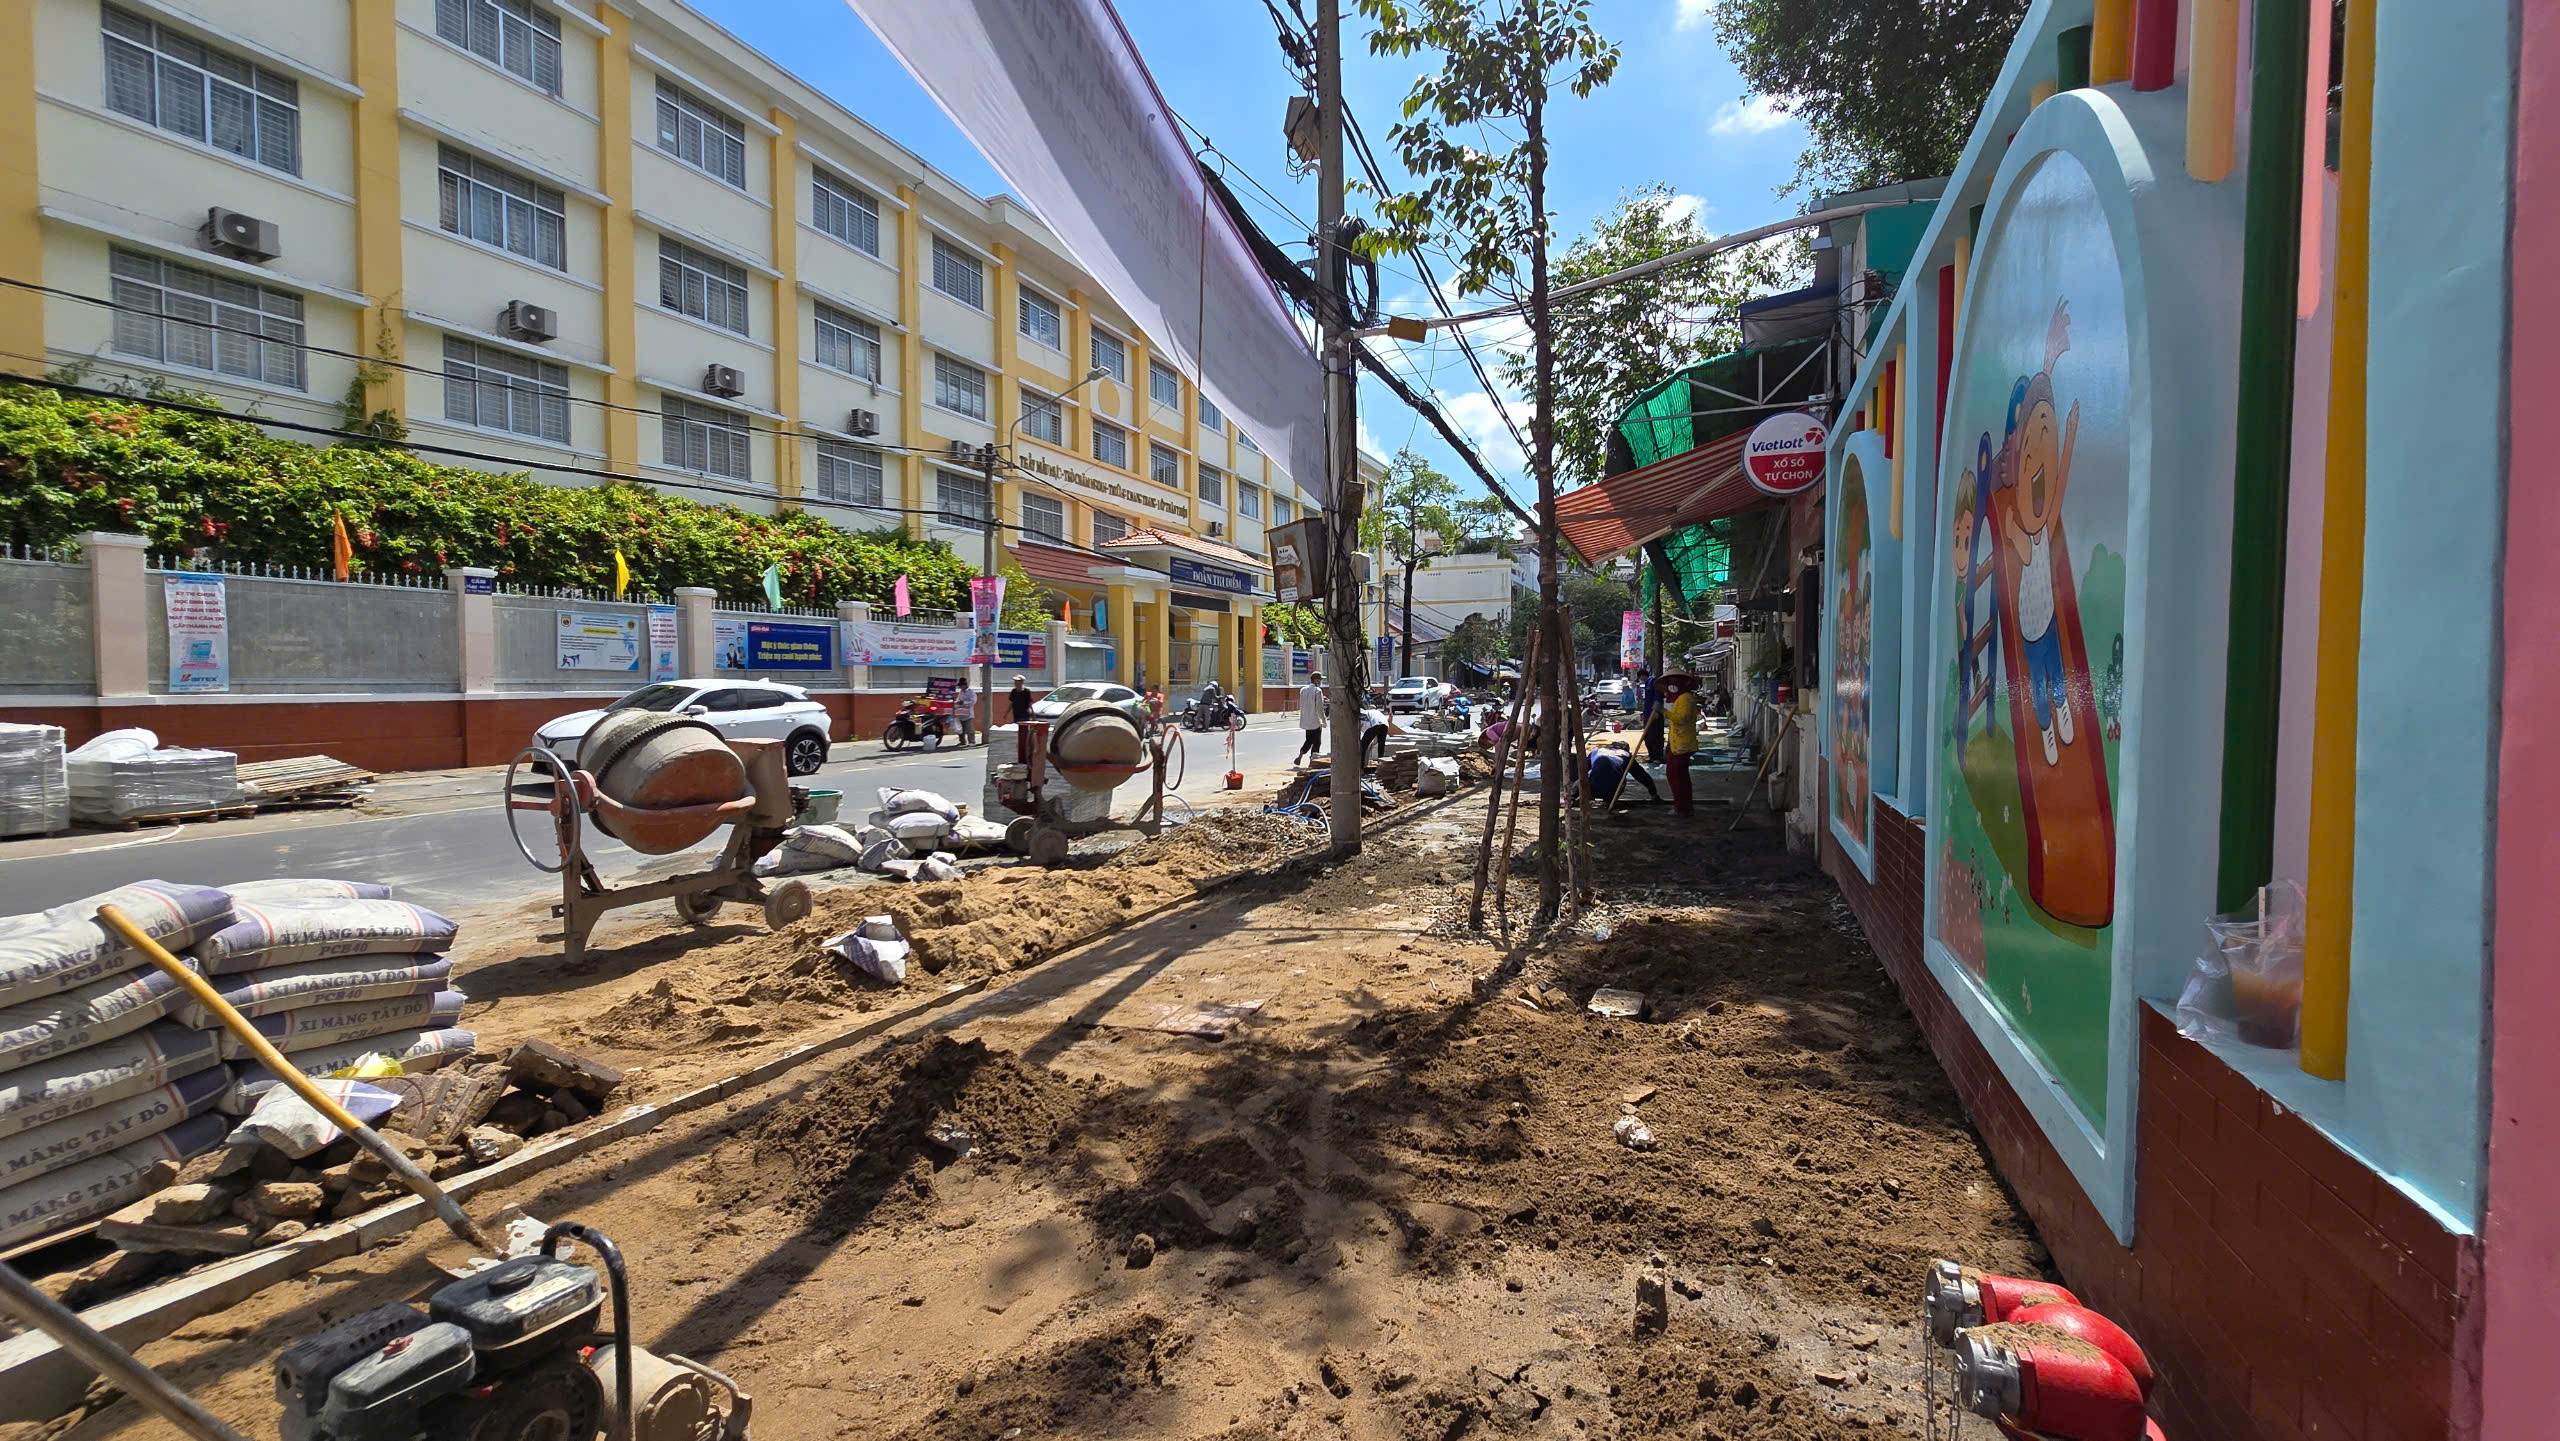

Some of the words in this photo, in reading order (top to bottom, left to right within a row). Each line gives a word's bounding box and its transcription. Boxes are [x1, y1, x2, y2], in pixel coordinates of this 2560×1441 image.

[1752, 438, 1804, 452] Vietlott
[1790, 456, 1805, 467] SỐ
[1765, 471, 1781, 482] TỰ
[1781, 470, 1813, 481] CHỌN
[1193, 571, 1212, 585] ĐOÀN
[303, 926, 352, 942] MĂNG
[356, 926, 389, 938] TÂY
[60, 964, 102, 986] PCB
[104, 956, 124, 970] 40
[269, 984, 290, 998] XI
[291, 974, 345, 994] MĂNG
[350, 971, 380, 985] TÂY
[386, 968, 408, 981] ĐÔ
[299, 1019, 318, 1032] XI
[321, 1010, 367, 1029] MĂNG
[372, 1004, 402, 1021] TÂY
[404, 1000, 424, 1015] ĐÔ
[8, 1136, 82, 1173] MĂNG
[86, 1115, 135, 1144] TÂY
[139, 1100, 169, 1125] ĐÔ
[8, 1189, 84, 1227] MĂNG
[88, 1170, 135, 1194] TÂY
